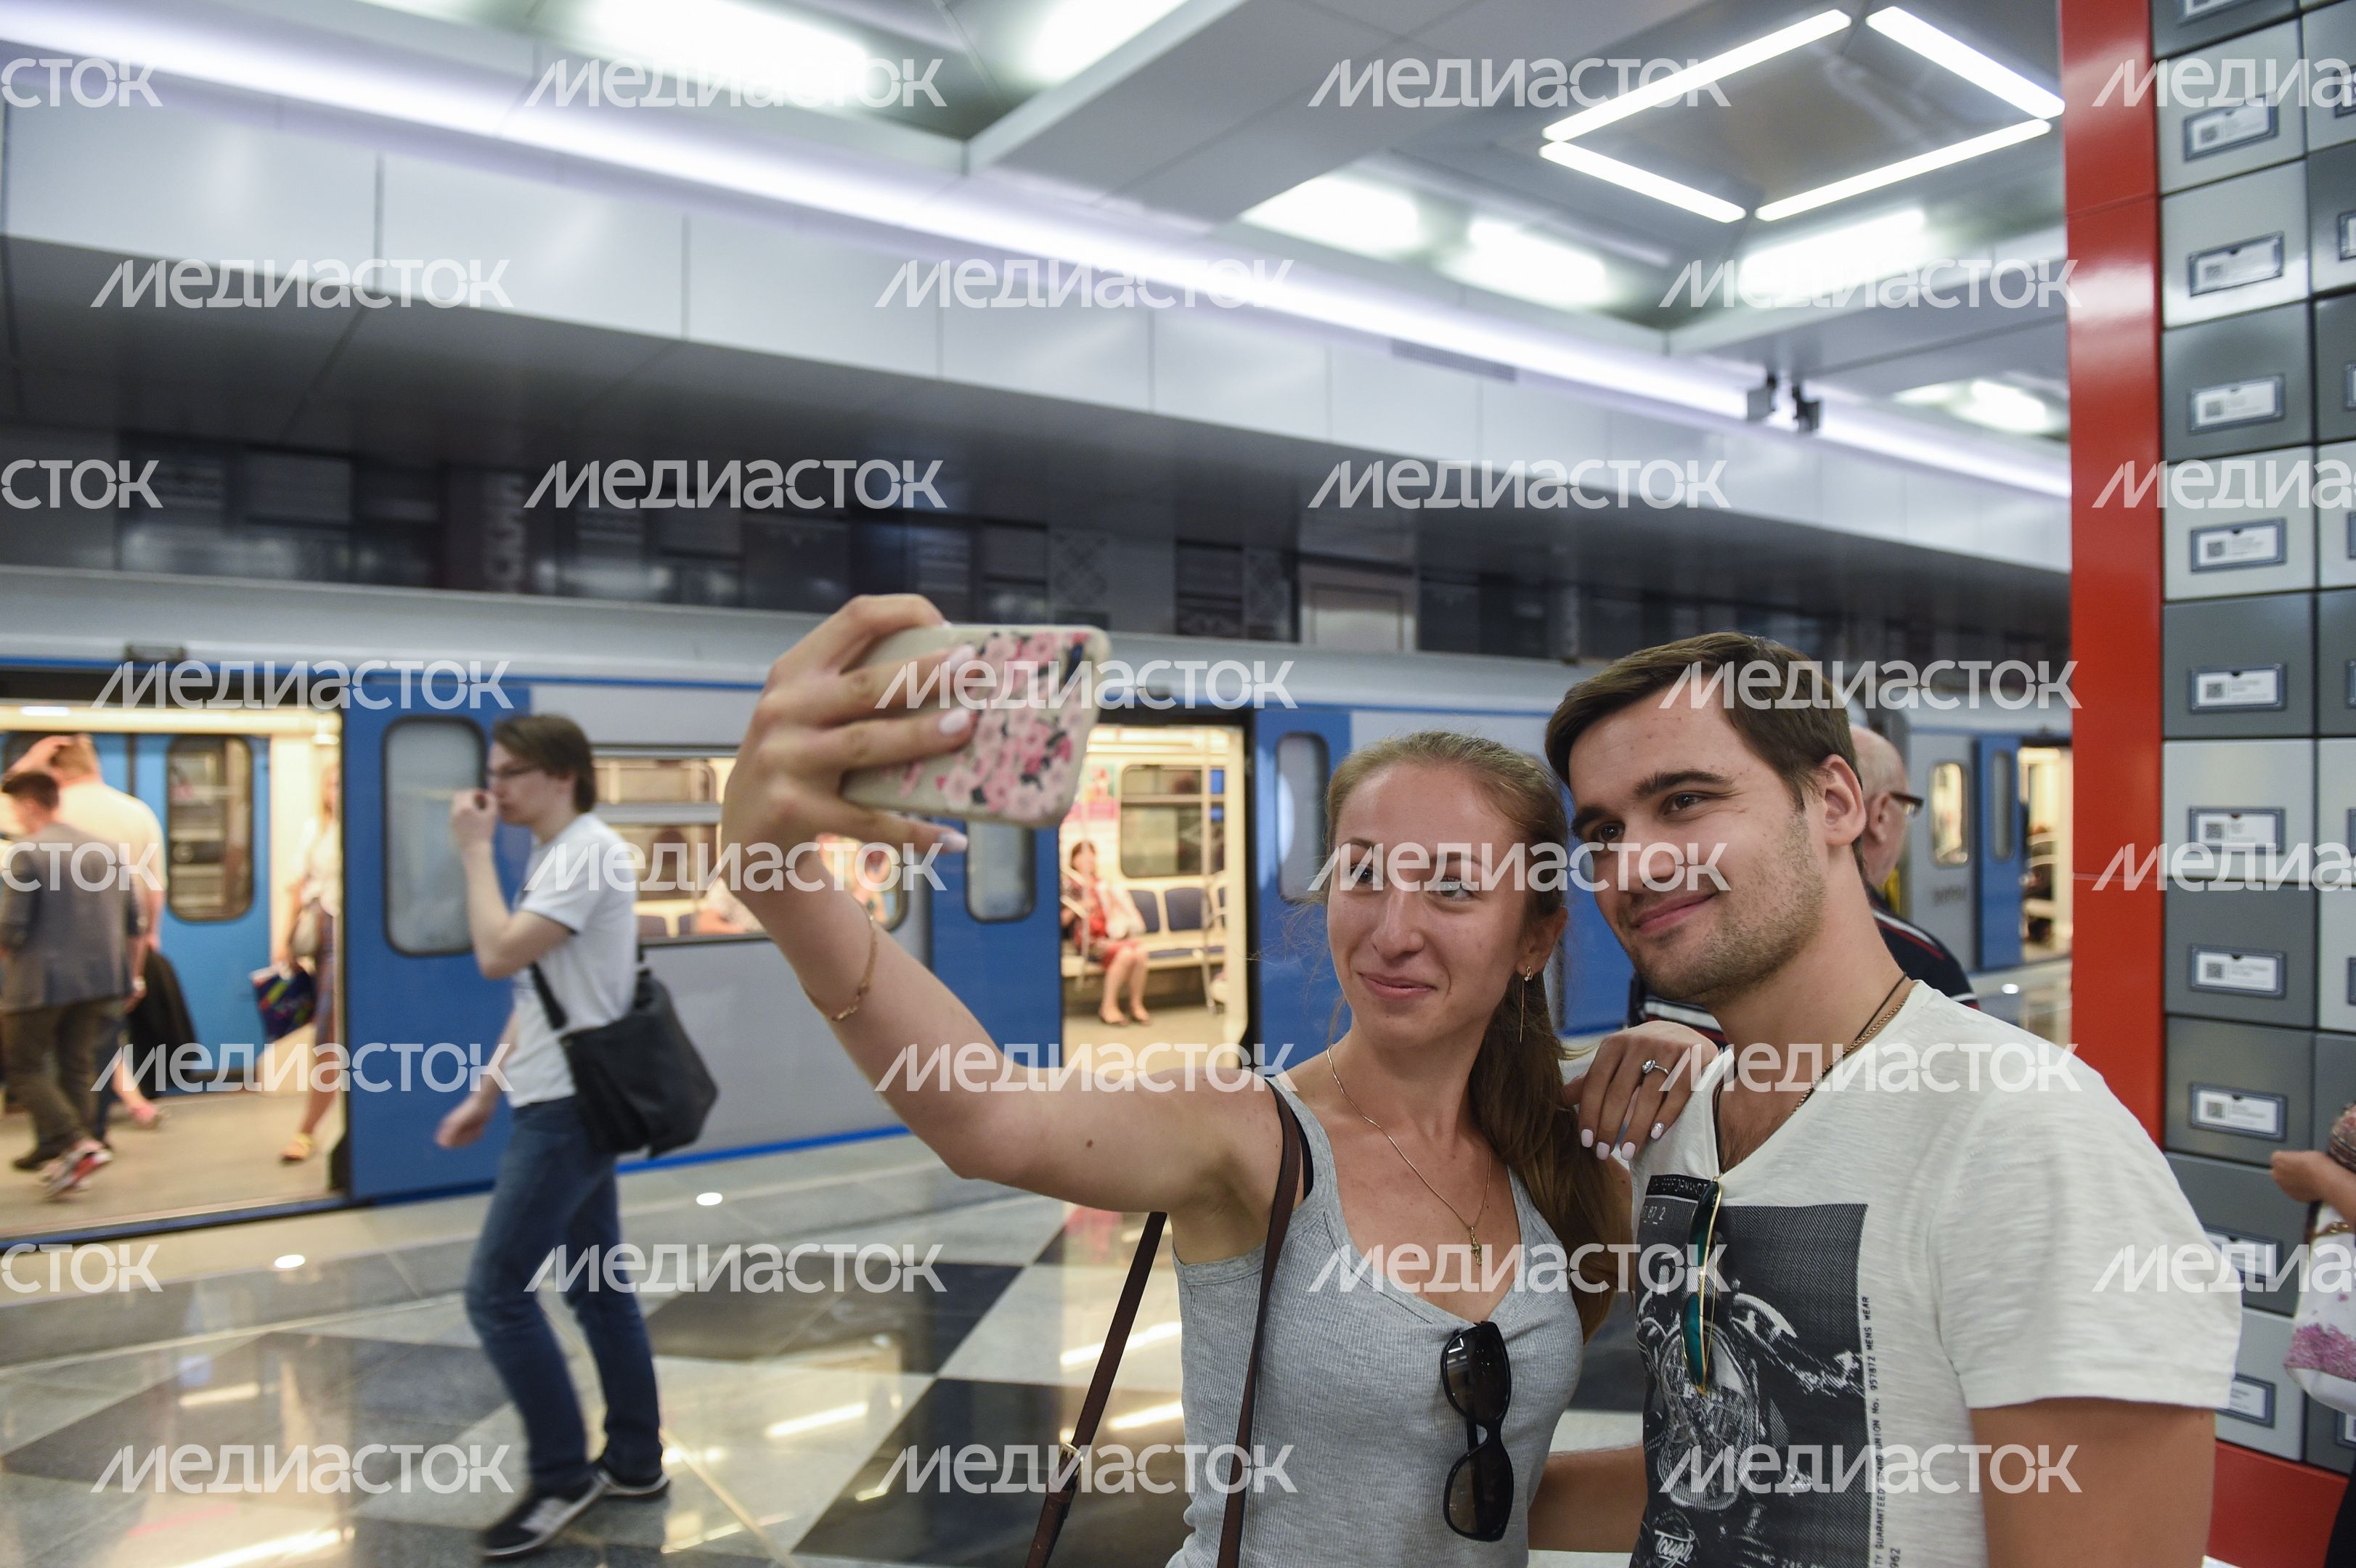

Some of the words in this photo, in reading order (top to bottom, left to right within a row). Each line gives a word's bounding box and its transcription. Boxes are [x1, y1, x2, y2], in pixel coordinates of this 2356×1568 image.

[1862, 1296, 1872, 1321] WEAR
[1864, 1327, 1874, 1351] MENS
[1867, 1355, 1878, 1392] 957872
[1872, 1420, 1883, 1450] UNION
[1875, 1489, 1885, 1550] GUARANTEED
